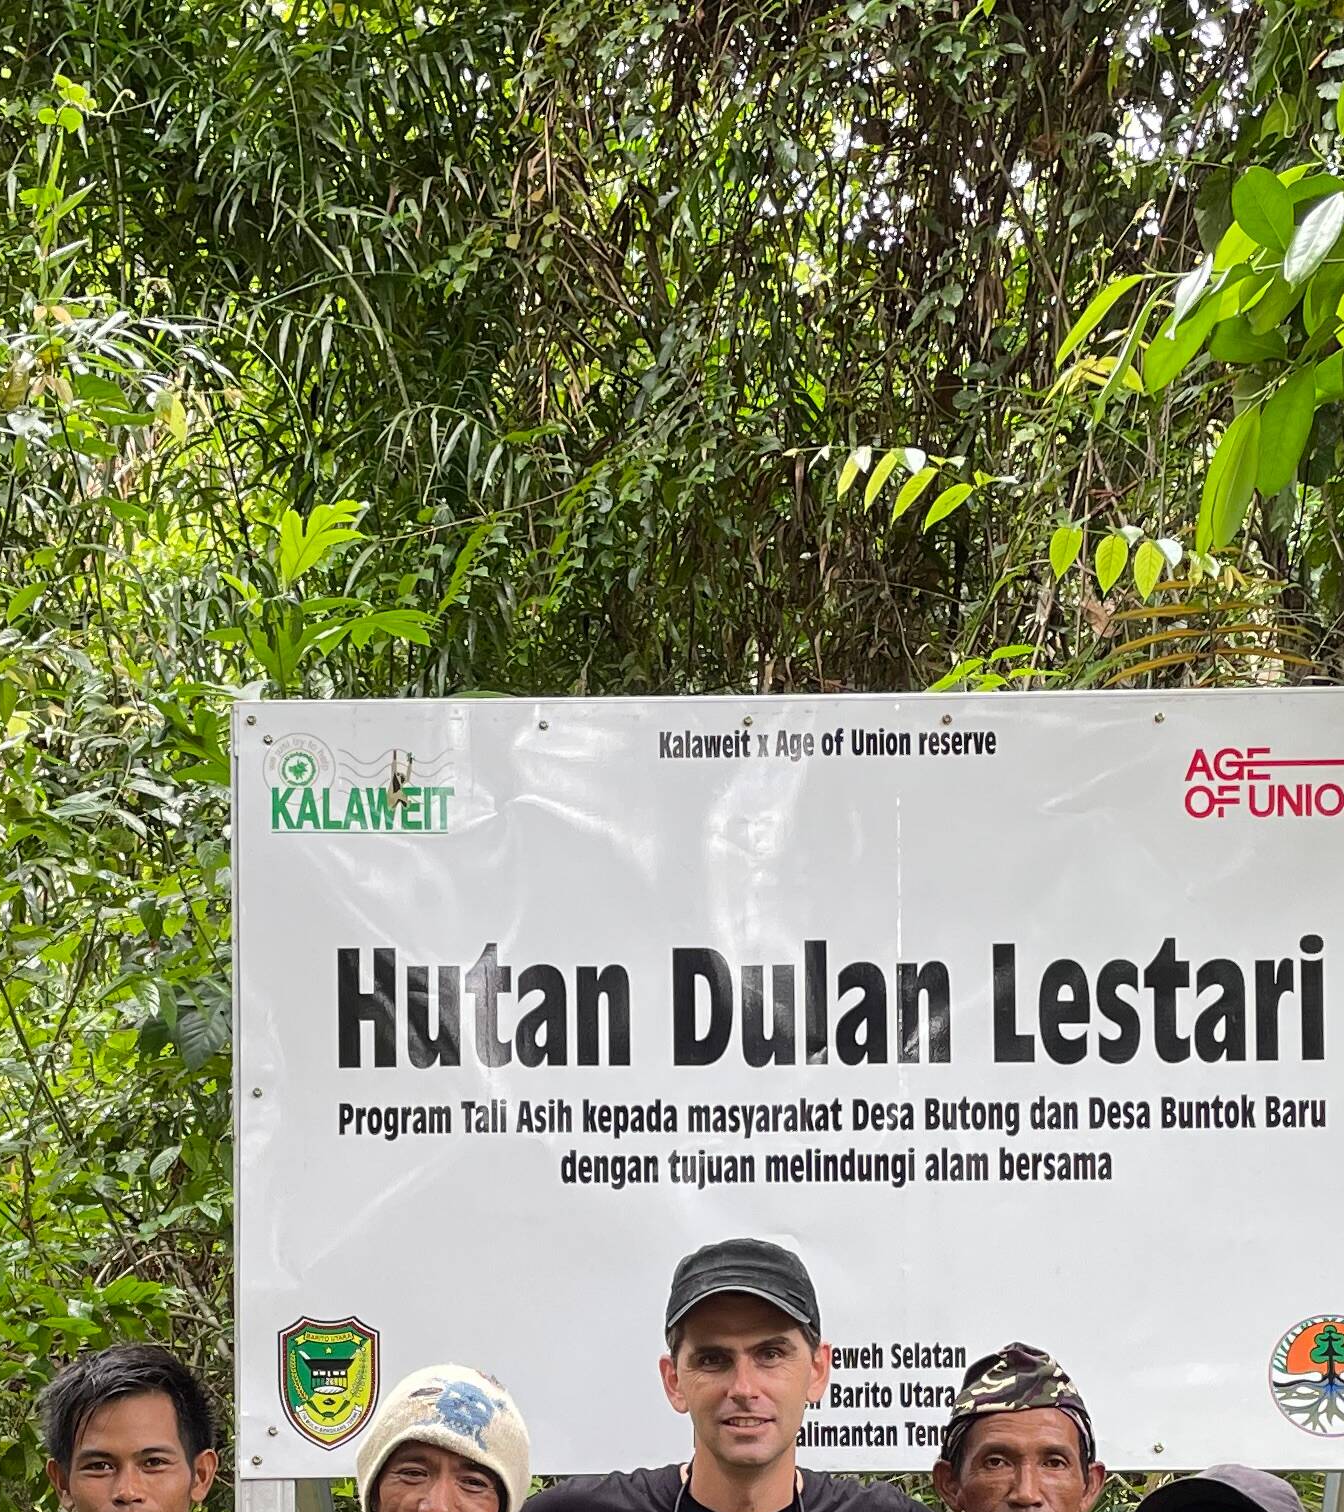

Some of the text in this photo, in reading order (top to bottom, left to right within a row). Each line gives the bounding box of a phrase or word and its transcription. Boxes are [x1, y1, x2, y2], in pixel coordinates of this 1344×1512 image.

[660, 728, 997, 761] Kalaweit x Age of Union reserve
[272, 787, 454, 829] KALAWEIT
[1185, 785, 1240, 818] OF
[337, 934, 1325, 1069] Hutan Dulan Lestari
[339, 1095, 1326, 1141] Program Tali Asih kepada masyarakat Desa Butong dan Desa Buntok Baru
[561, 1147, 1112, 1190] dengan tujuan melindungi alam bersama
[830, 1342, 967, 1370] eweh Selatan
[830, 1381, 955, 1409] Barito Utara
[796, 1421, 898, 1447] alimantan
